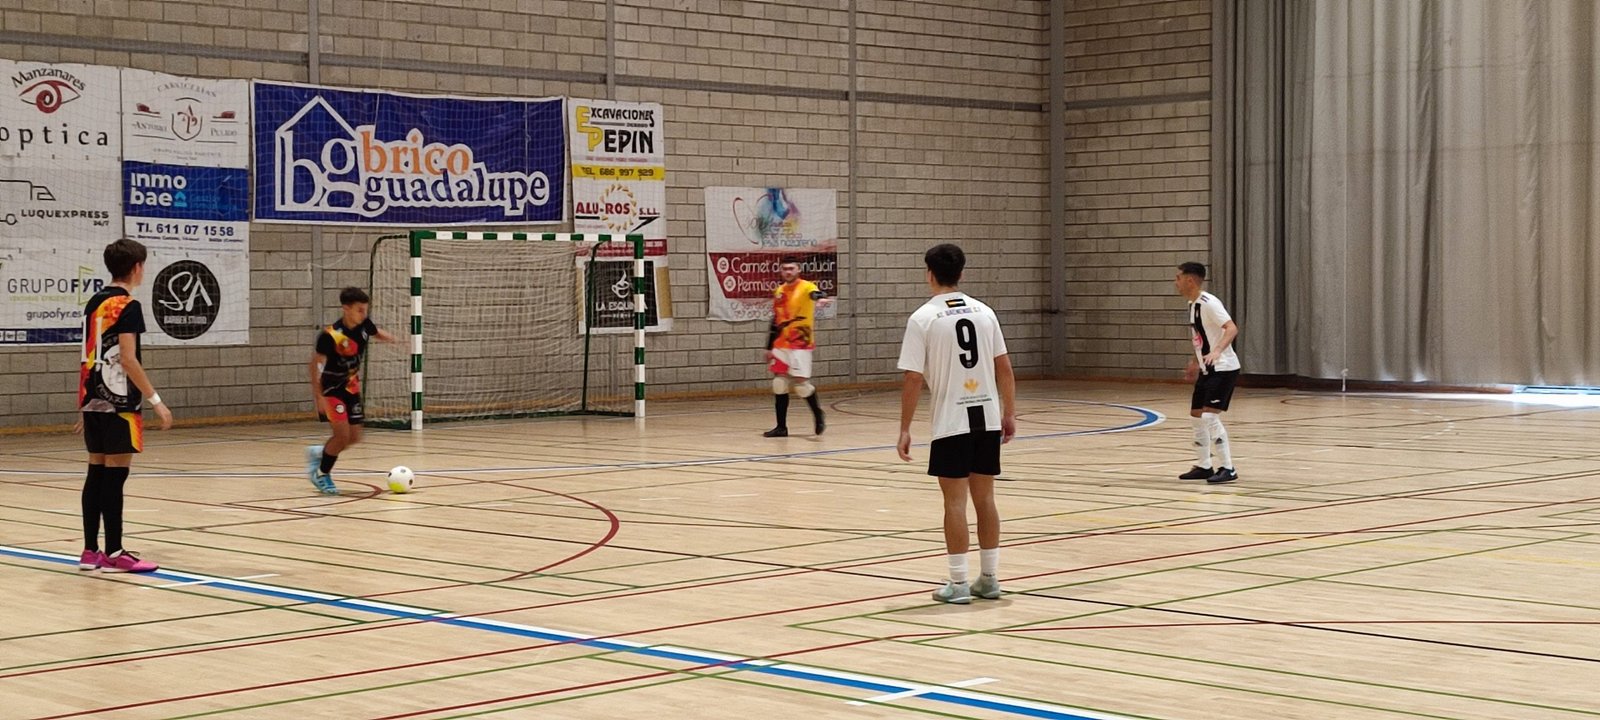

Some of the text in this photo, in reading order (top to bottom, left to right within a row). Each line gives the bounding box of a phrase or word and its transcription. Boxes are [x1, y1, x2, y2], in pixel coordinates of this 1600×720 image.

[11, 67, 87, 91] Manzanares
[360, 130, 471, 176] brico
[131, 172, 187, 189] inmo
[599, 168, 615, 176] 686
[130, 187, 173, 207] bae
[362, 167, 547, 212] guadalupe
[21, 209, 109, 219] LUQUEXPRESS
[575, 202, 631, 215] ALU-ROS
[156, 223, 179, 234] 611
[184, 225, 199, 235] 07
[731, 257, 770, 274] Carnet
[800, 257, 835, 272] nducir
[7, 278, 104, 294] GRUPOFYR
[737, 275, 783, 292] Permisos
[608, 301, 648, 312] ESQUI
[955, 319, 978, 369] 9
